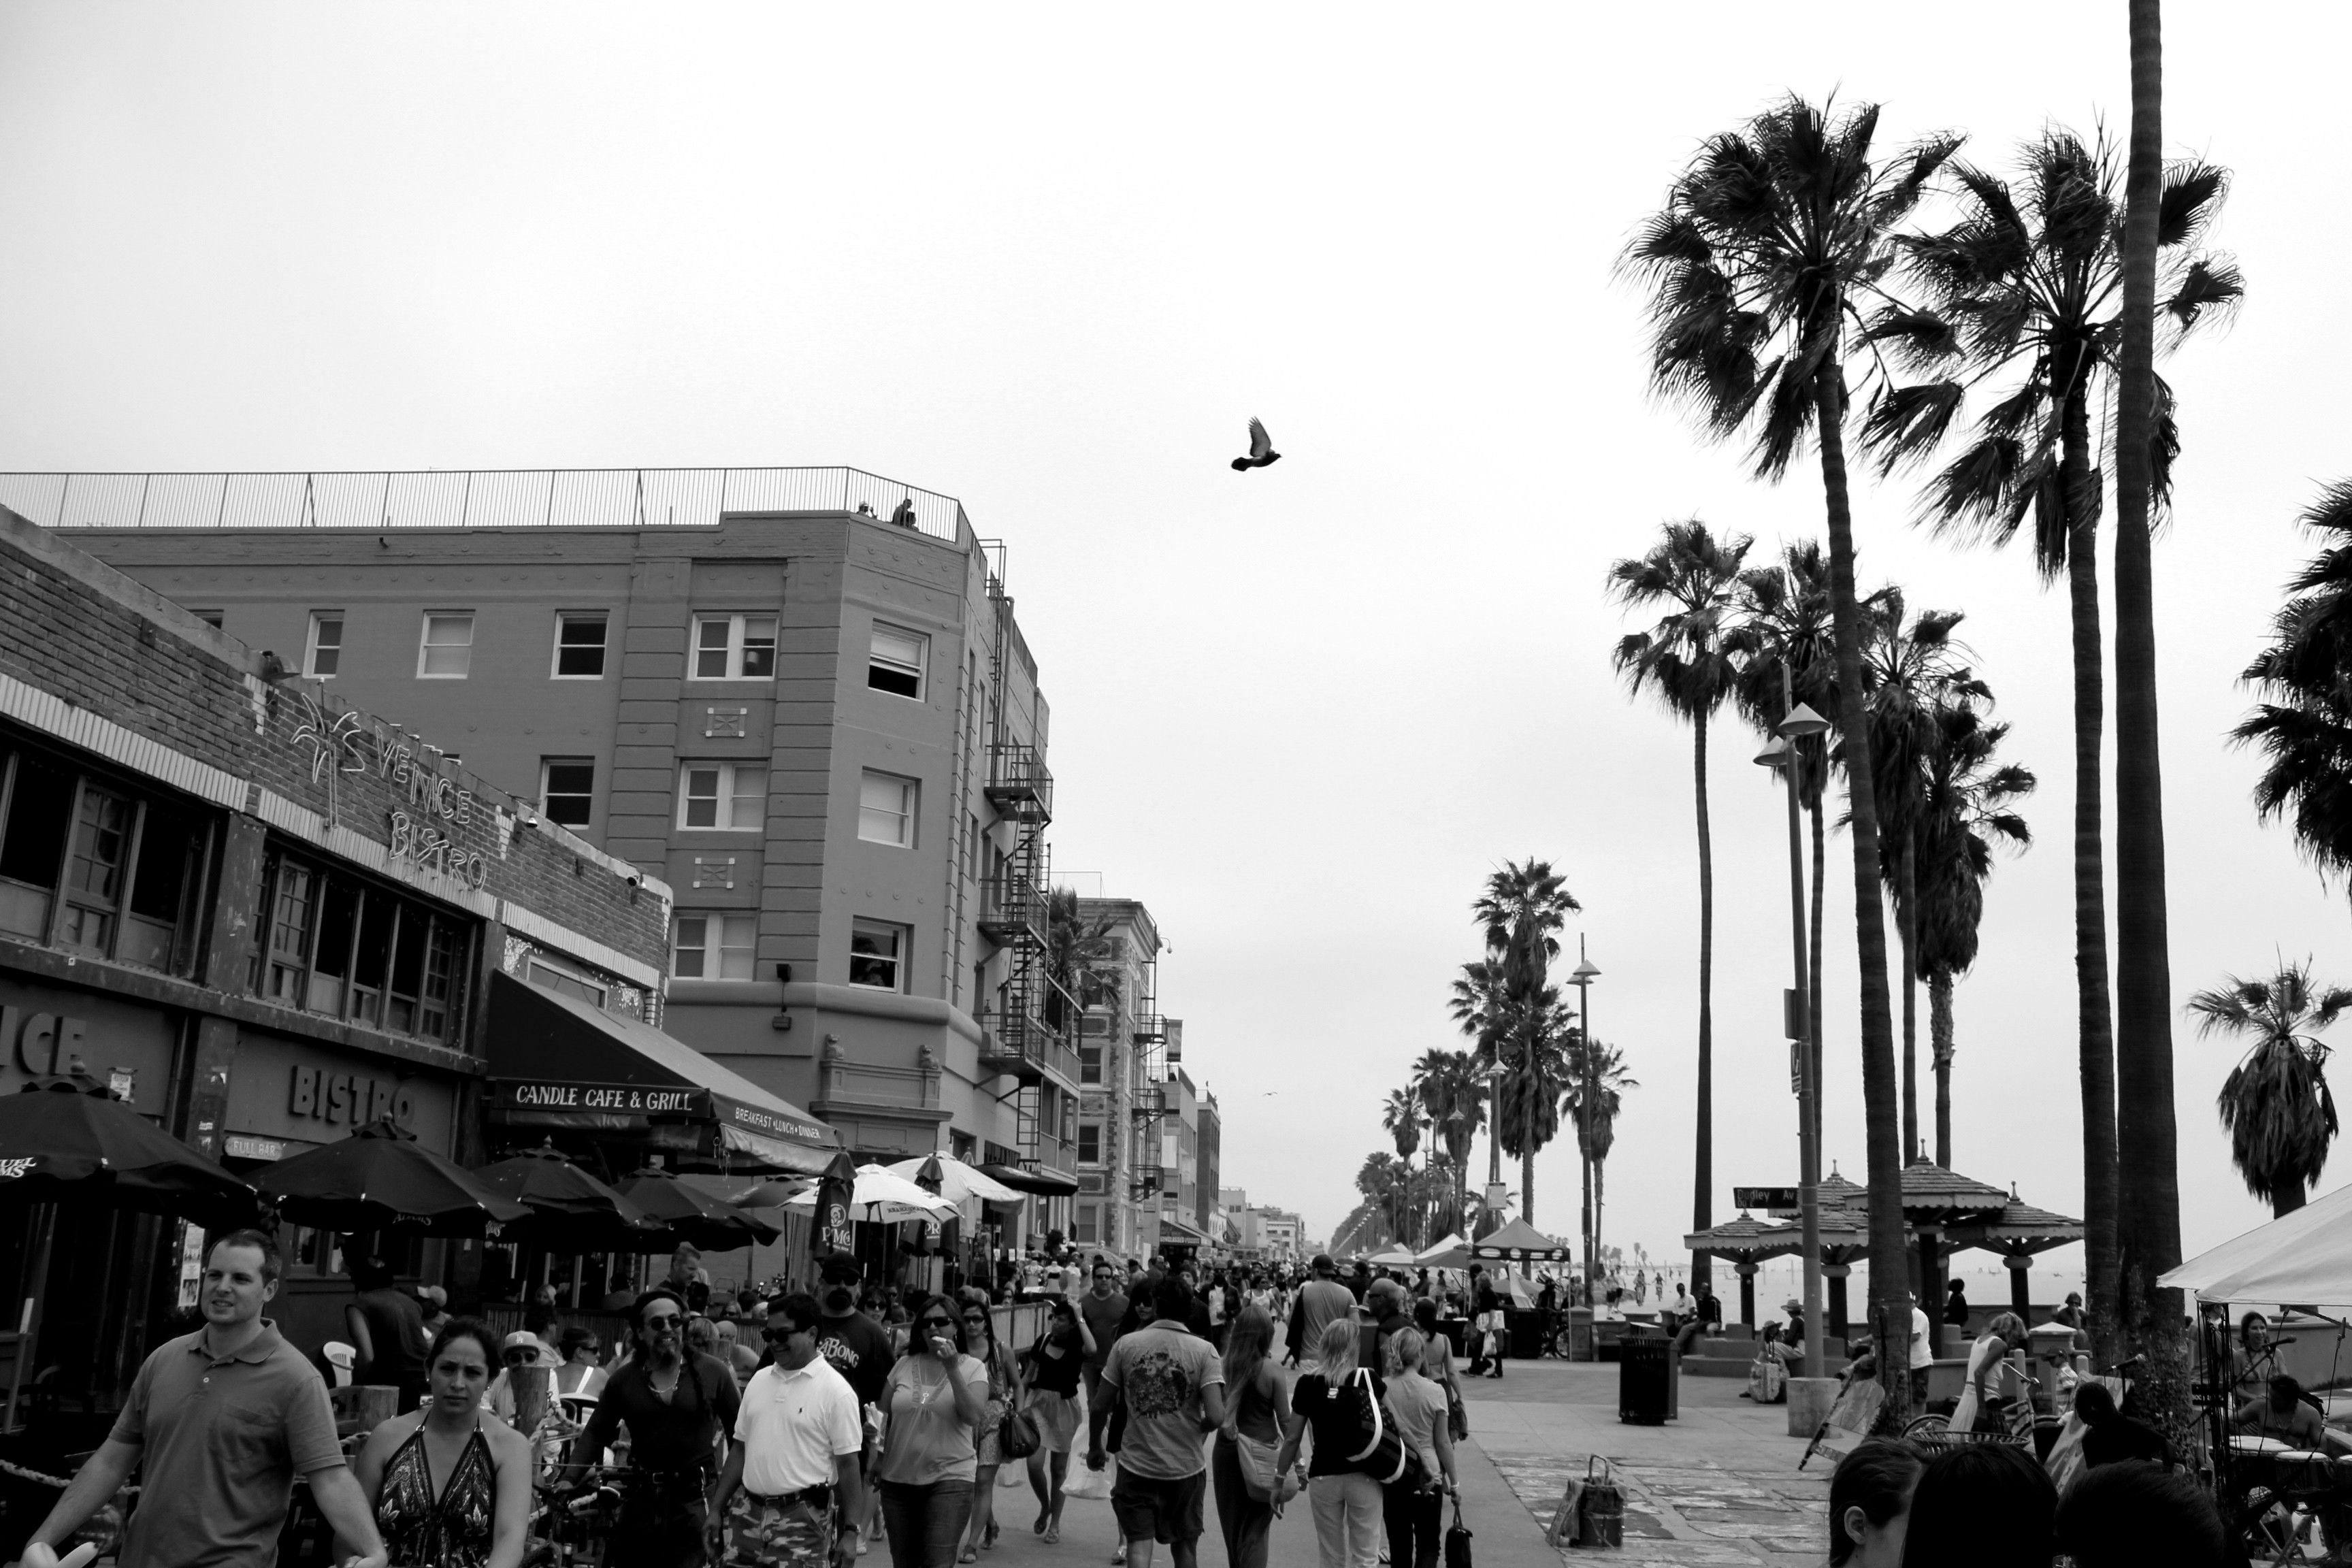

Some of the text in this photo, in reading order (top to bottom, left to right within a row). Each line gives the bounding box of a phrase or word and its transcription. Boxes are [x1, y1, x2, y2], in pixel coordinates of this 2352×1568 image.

[375, 725, 472, 825] VENICE
[389, 811, 487, 891] BISTRO
[291, 1065, 415, 1127] BISTRO
[516, 1085, 693, 1111] CANDLE CAFE & GRILL
[735, 1107, 772, 1128] BREAKFAST
[798, 1124, 821, 1139] DINNER
[1017, 1160, 1041, 1173] ATM
[1737, 1188, 1795, 1203] Dudley Av
[817, 1337, 860, 1369] ABONG
